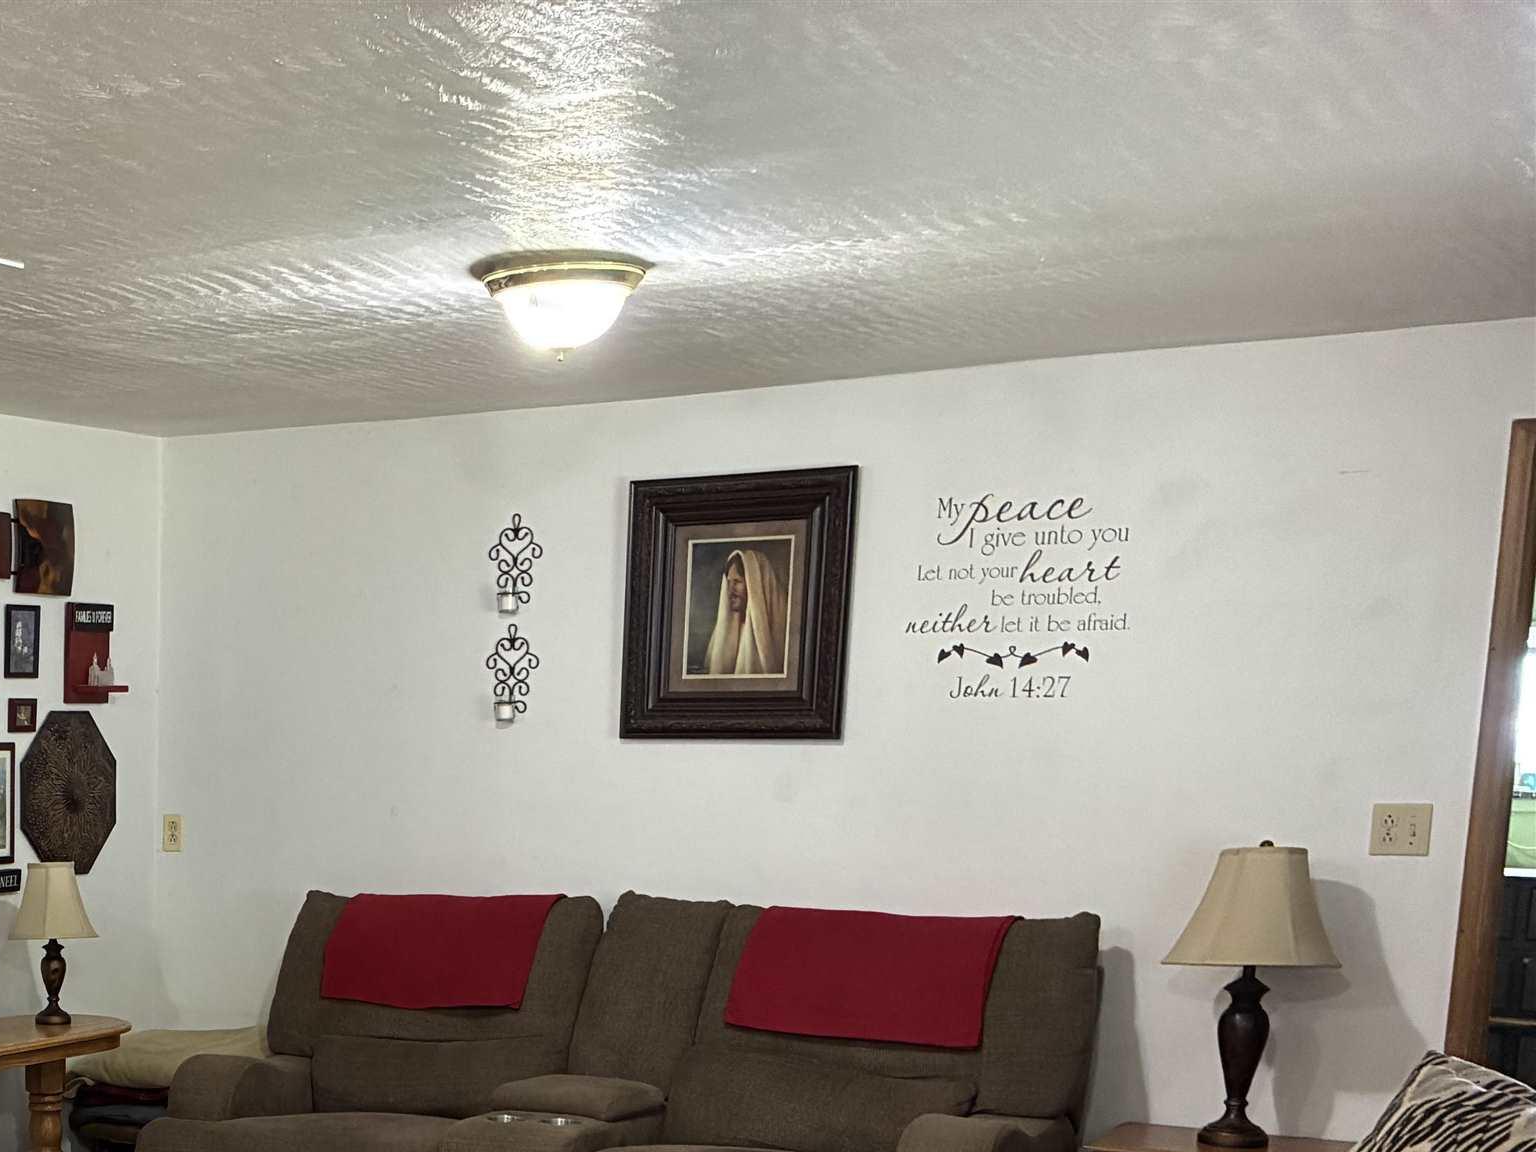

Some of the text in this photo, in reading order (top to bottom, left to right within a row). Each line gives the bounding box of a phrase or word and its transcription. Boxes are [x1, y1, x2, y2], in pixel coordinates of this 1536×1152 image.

[937, 493, 1094, 546] My peace
[969, 525, 1129, 556] I give unto you
[917, 549, 1121, 585] Let not your heart
[991, 589, 1014, 606] be
[905, 603, 1131, 634] neither let it be afraid.
[949, 674, 1072, 699] John 14:27
